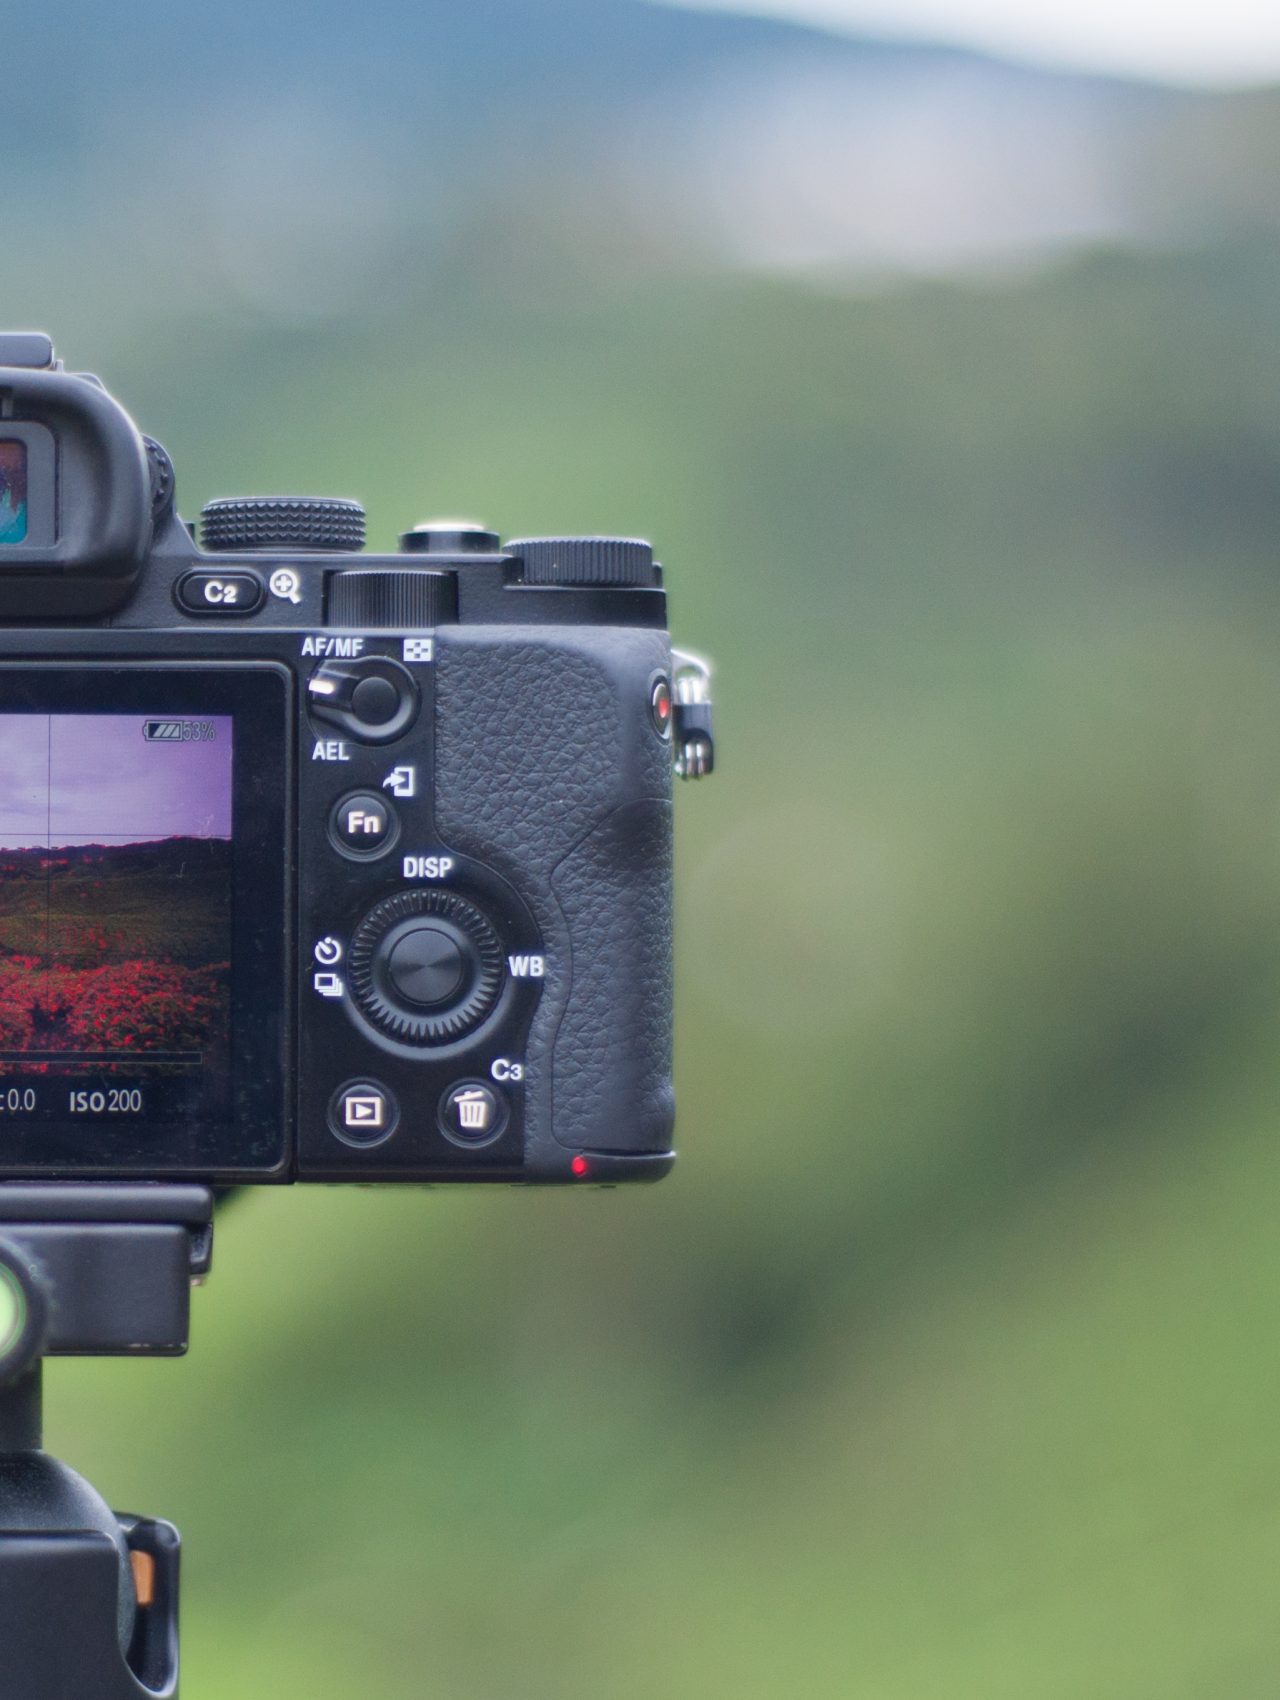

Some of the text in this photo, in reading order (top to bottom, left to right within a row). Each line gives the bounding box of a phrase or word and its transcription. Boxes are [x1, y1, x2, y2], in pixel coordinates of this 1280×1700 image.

[204, 580, 237, 604] C2
[301, 637, 363, 656] AF/MF
[182, 720, 216, 741] 53%
[312, 742, 350, 760] AEL
[348, 811, 380, 833] Fn
[403, 857, 453, 878] DISP
[509, 956, 544, 977] WB
[491, 1059, 523, 1081] C3
